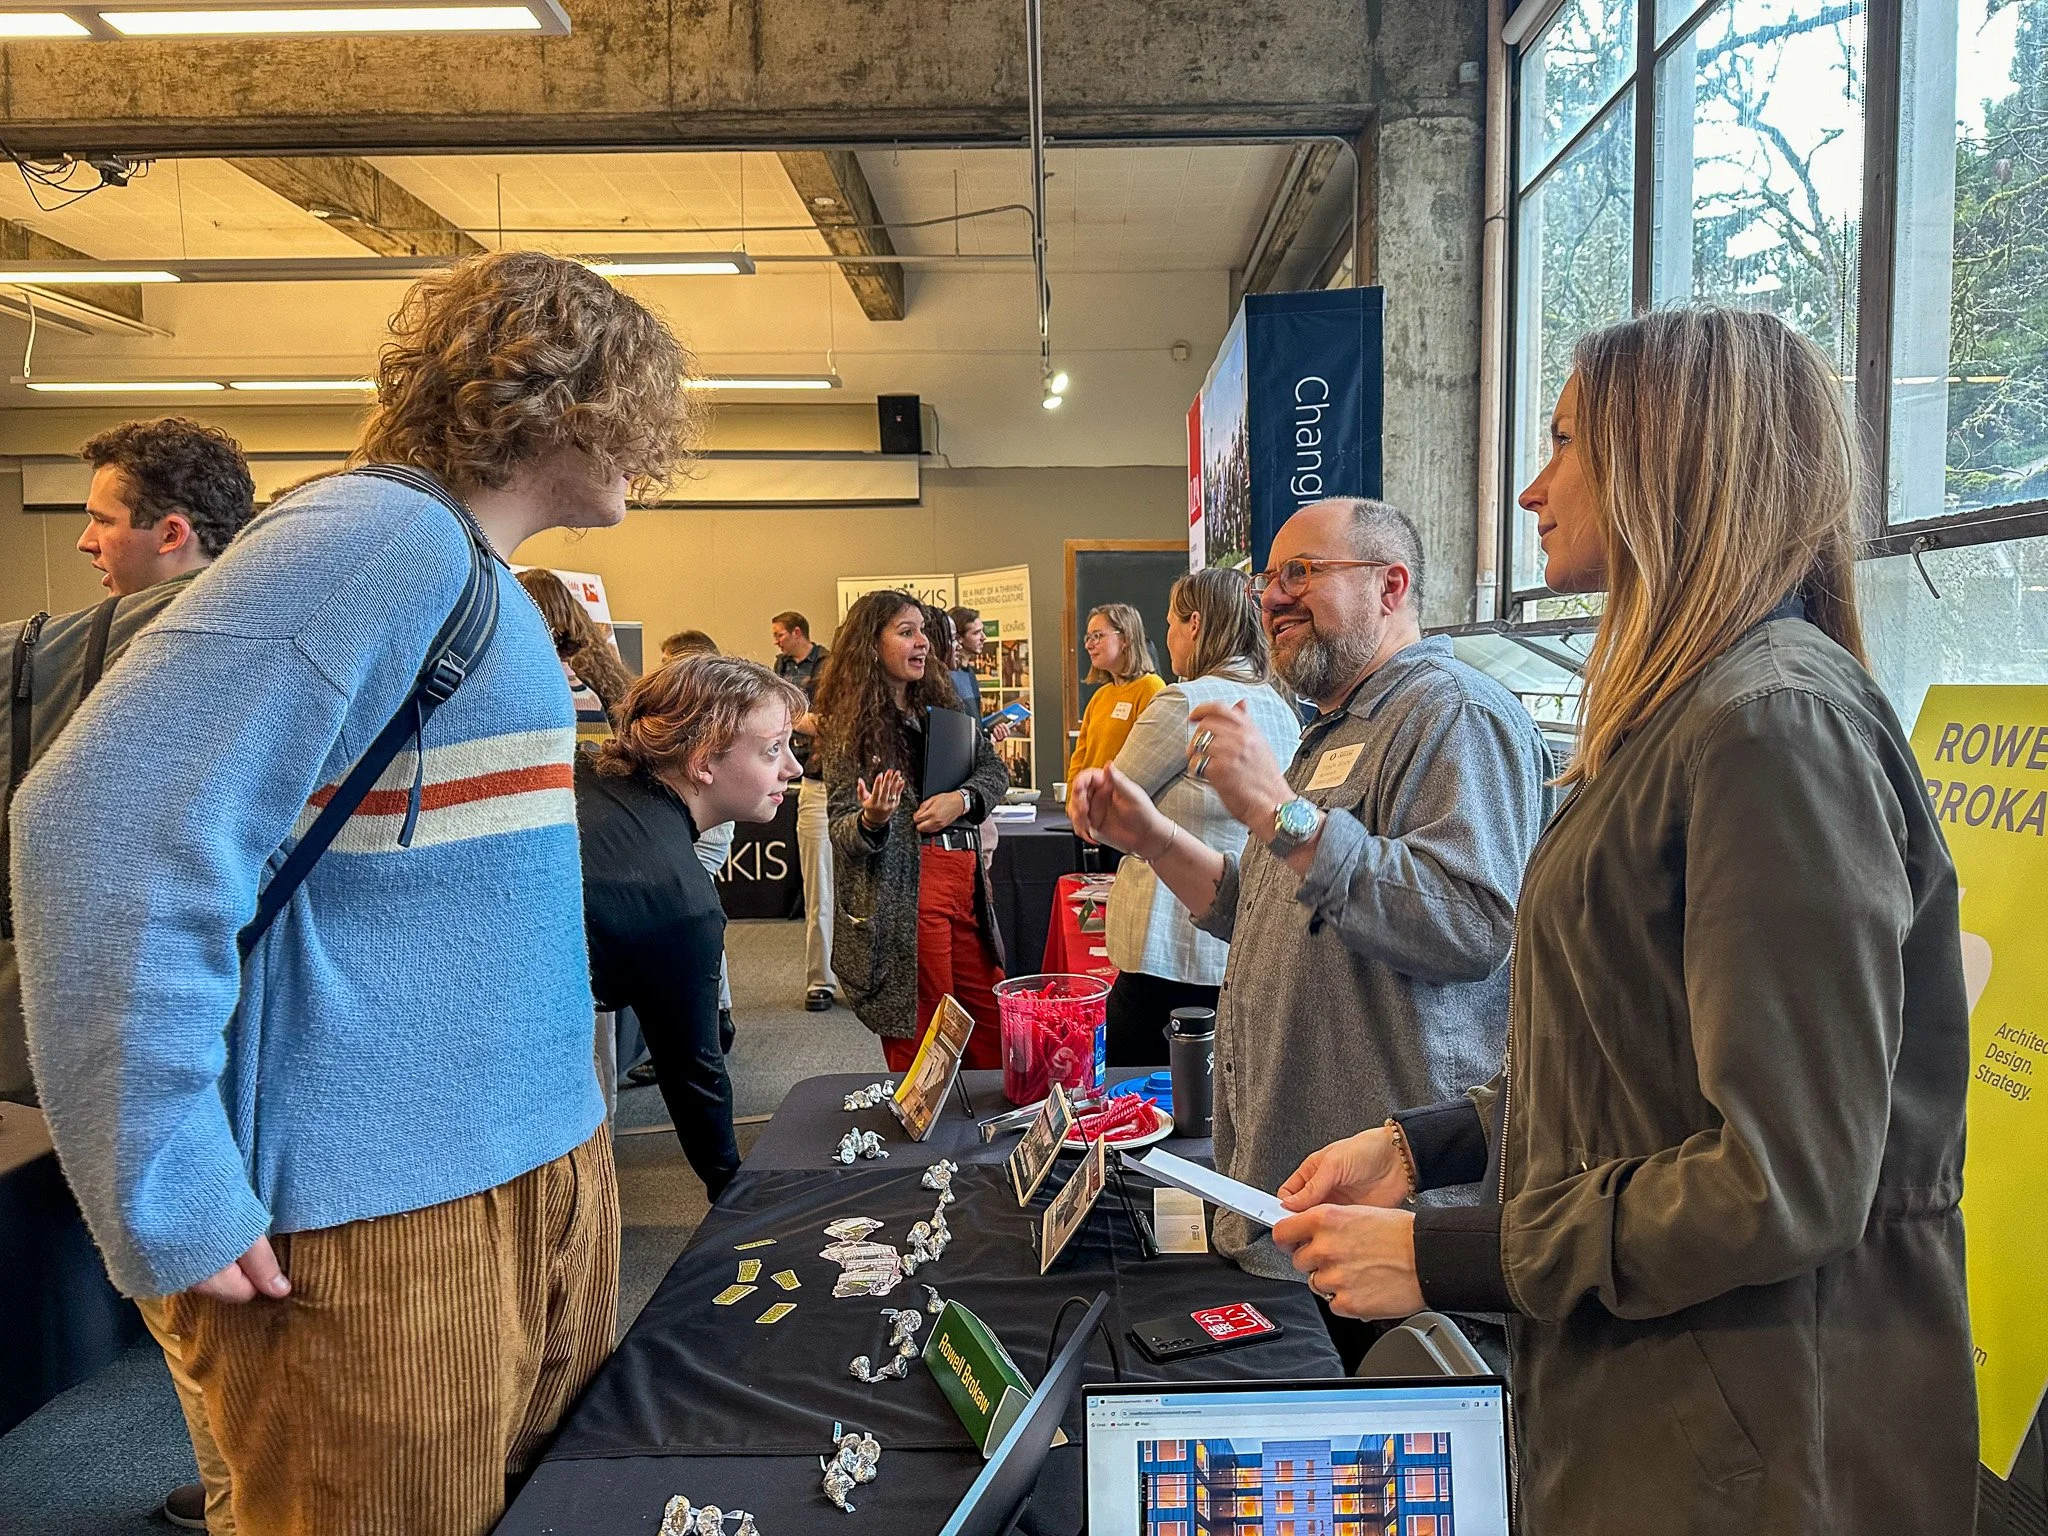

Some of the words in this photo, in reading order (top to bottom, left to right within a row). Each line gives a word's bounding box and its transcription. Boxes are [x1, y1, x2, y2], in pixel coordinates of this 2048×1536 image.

[1934, 722, 2048, 771] ROWE
[716, 840, 788, 883] KIS
[1984, 1042, 2032, 1075] Design.
[1974, 1064, 2032, 1101] Strategy.
[938, 1332, 966, 1377] Rowell
[961, 1363, 991, 1416] Brokaw
